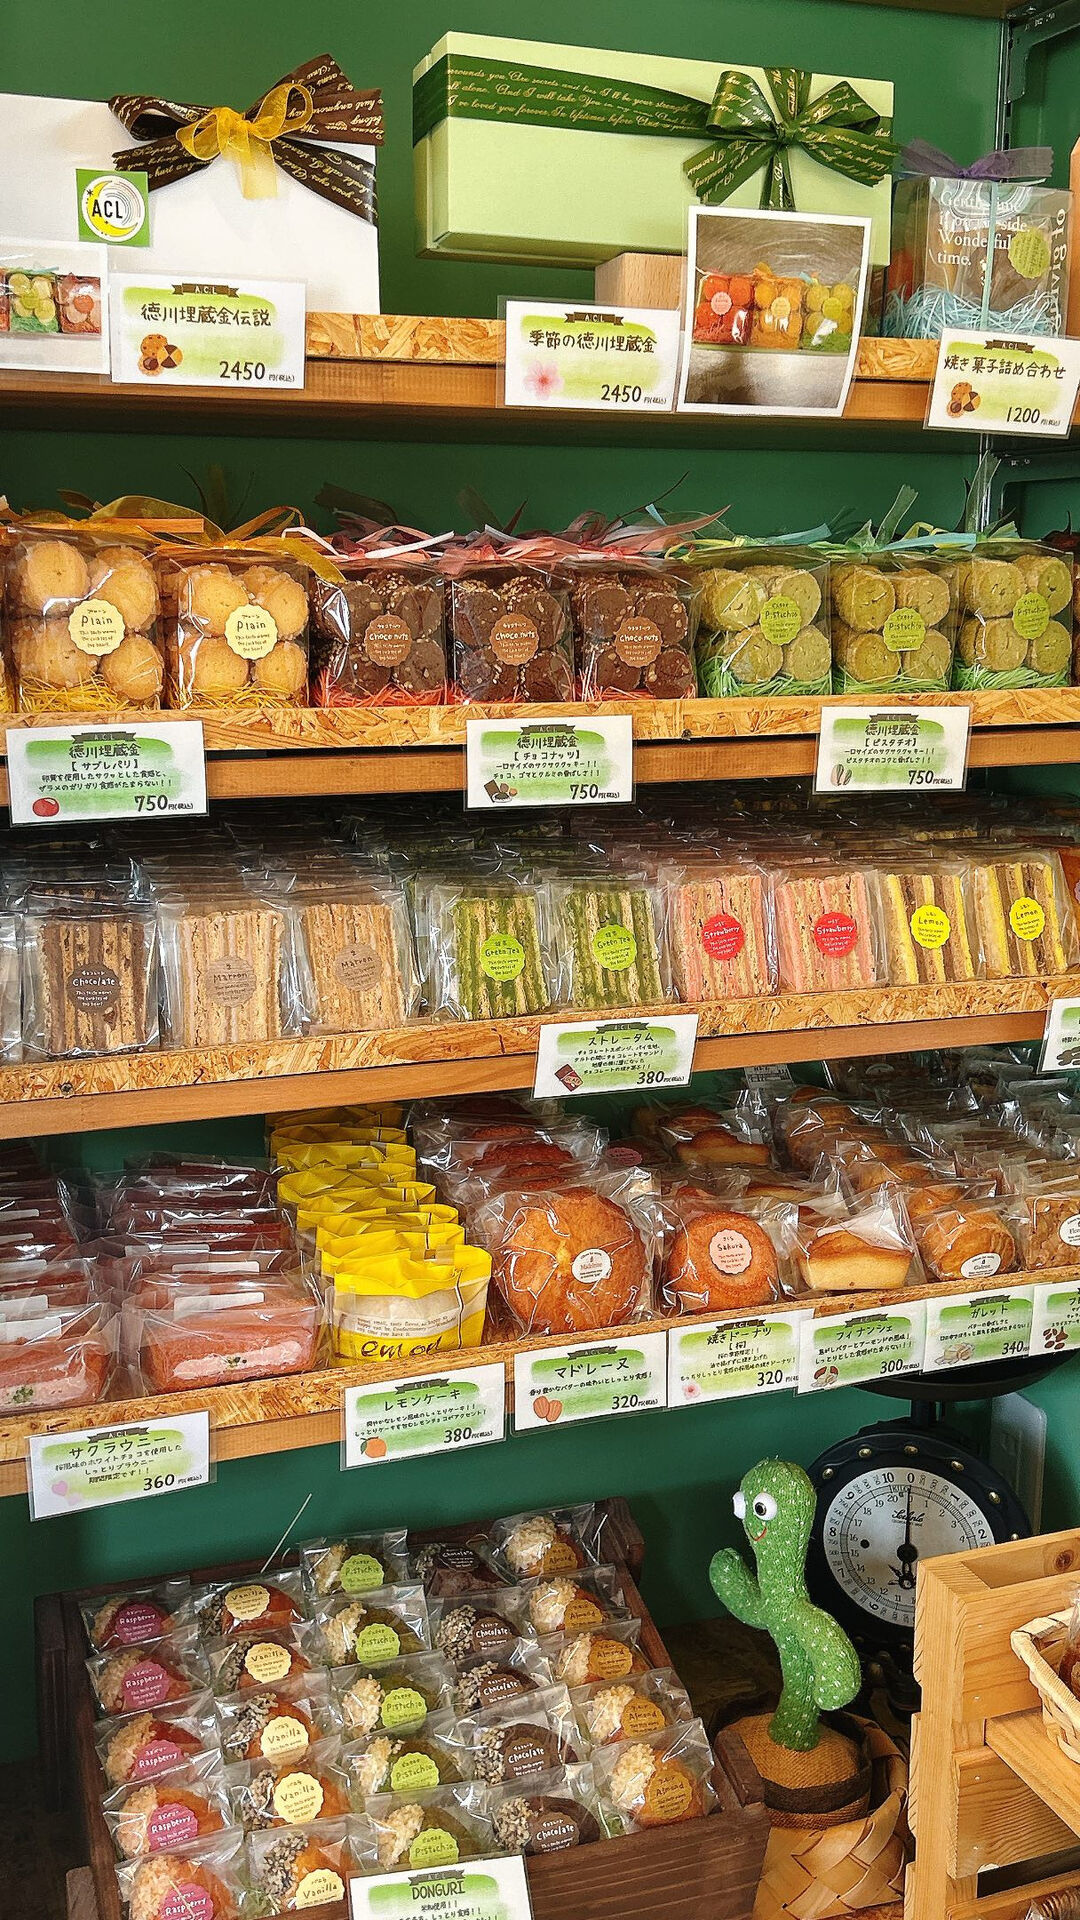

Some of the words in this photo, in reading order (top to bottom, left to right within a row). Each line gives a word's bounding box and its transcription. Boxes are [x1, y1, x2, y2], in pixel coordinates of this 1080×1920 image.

[91, 199, 123, 219] ACL
[938, 229, 1012, 249] Wondeful
[141, 302, 272, 327] 徳川埋蔵金伝説
[529, 330, 657, 354] 季節の徳川埋蔵金
[219, 361, 266, 381] 2450
[944, 355, 1066, 380] 焼き菓子詰め合わせ
[601, 384, 642, 403] 2450
[1006, 407, 1040, 424] 1200
[82, 615, 113, 627] Plain
[237, 620, 267, 632] Plain
[865, 724, 921, 736] 徳川埋蔵金
[517, 736, 579, 750] 徳川埋蔵金
[69, 743, 142, 759] 徳川埋蔵金
[908, 770, 934, 785] 750
[570, 783, 599, 800] 750
[134, 795, 168, 812] 750
[918, 917, 944, 926] Lemon
[1015, 910, 1038, 920] Lemon
[704, 926, 740, 939] Strawberry
[816, 925, 855, 935] Strawberry
[597, 939, 618, 949] Green
[619, 936, 631, 944] Tea
[341, 956, 373, 968] Marron
[72, 978, 115, 986] Chocolate
[588, 1032, 654, 1047] ストレータム
[637, 1071, 664, 1085] 380
[717, 1243, 743, 1251] Sakura
[971, 1305, 1009, 1319] ガレット
[707, 1327, 772, 1346] 焼きドーナツ
[836, 1325, 893, 1340] フィナンシェ
[1002, 1341, 1024, 1355] 340
[554, 1358, 629, 1379] マドレーヌ
[880, 1359, 903, 1374] 300
[757, 1370, 783, 1387] 320
[385, 1389, 461, 1411] レモンケーキ
[612, 1394, 639, 1410] 320
[444, 1427, 472, 1444] 380
[69, 1438, 166, 1459] サクラウニー
[143, 1473, 175, 1491] 360
[882, 1472, 895, 1484] 10
[907, 1473, 915, 1483] 0
[874, 1500, 884, 1508] 19
[887, 1494, 899, 1503] 20
[863, 1507, 872, 1515] 18
[854, 1519, 863, 1527] 17
[829, 1527, 837, 1537] 8
[849, 1534, 858, 1542] 16
[978, 1529, 987, 1539] 2
[850, 1549, 860, 1557] 15
[837, 1568, 846, 1578] 7
[856, 1564, 865, 1573] 14
[866, 1577, 876, 1585] 13
[231, 1590, 263, 1601] Vanilla
[119, 1614, 156, 1625] Raspberry
[475, 1626, 508, 1638] Chocolate
[251, 1651, 284, 1662] Vanilla
[125, 1673, 163, 1688] Raspberry
[483, 1680, 518, 1696] Chocolate
[267, 1728, 301, 1744] Vanilla
[139, 1752, 178, 1768] Raspberry
[508, 1747, 545, 1764] Chocolate
[280, 1784, 315, 1802] Vanilla
[656, 1781, 685, 1797] Almond
[151, 1816, 191, 1834] Raspberry
[536, 1825, 575, 1841] Chocolate
[302, 1884, 338, 1899] Vanilla
[412, 1880, 466, 1900] DONGURI
